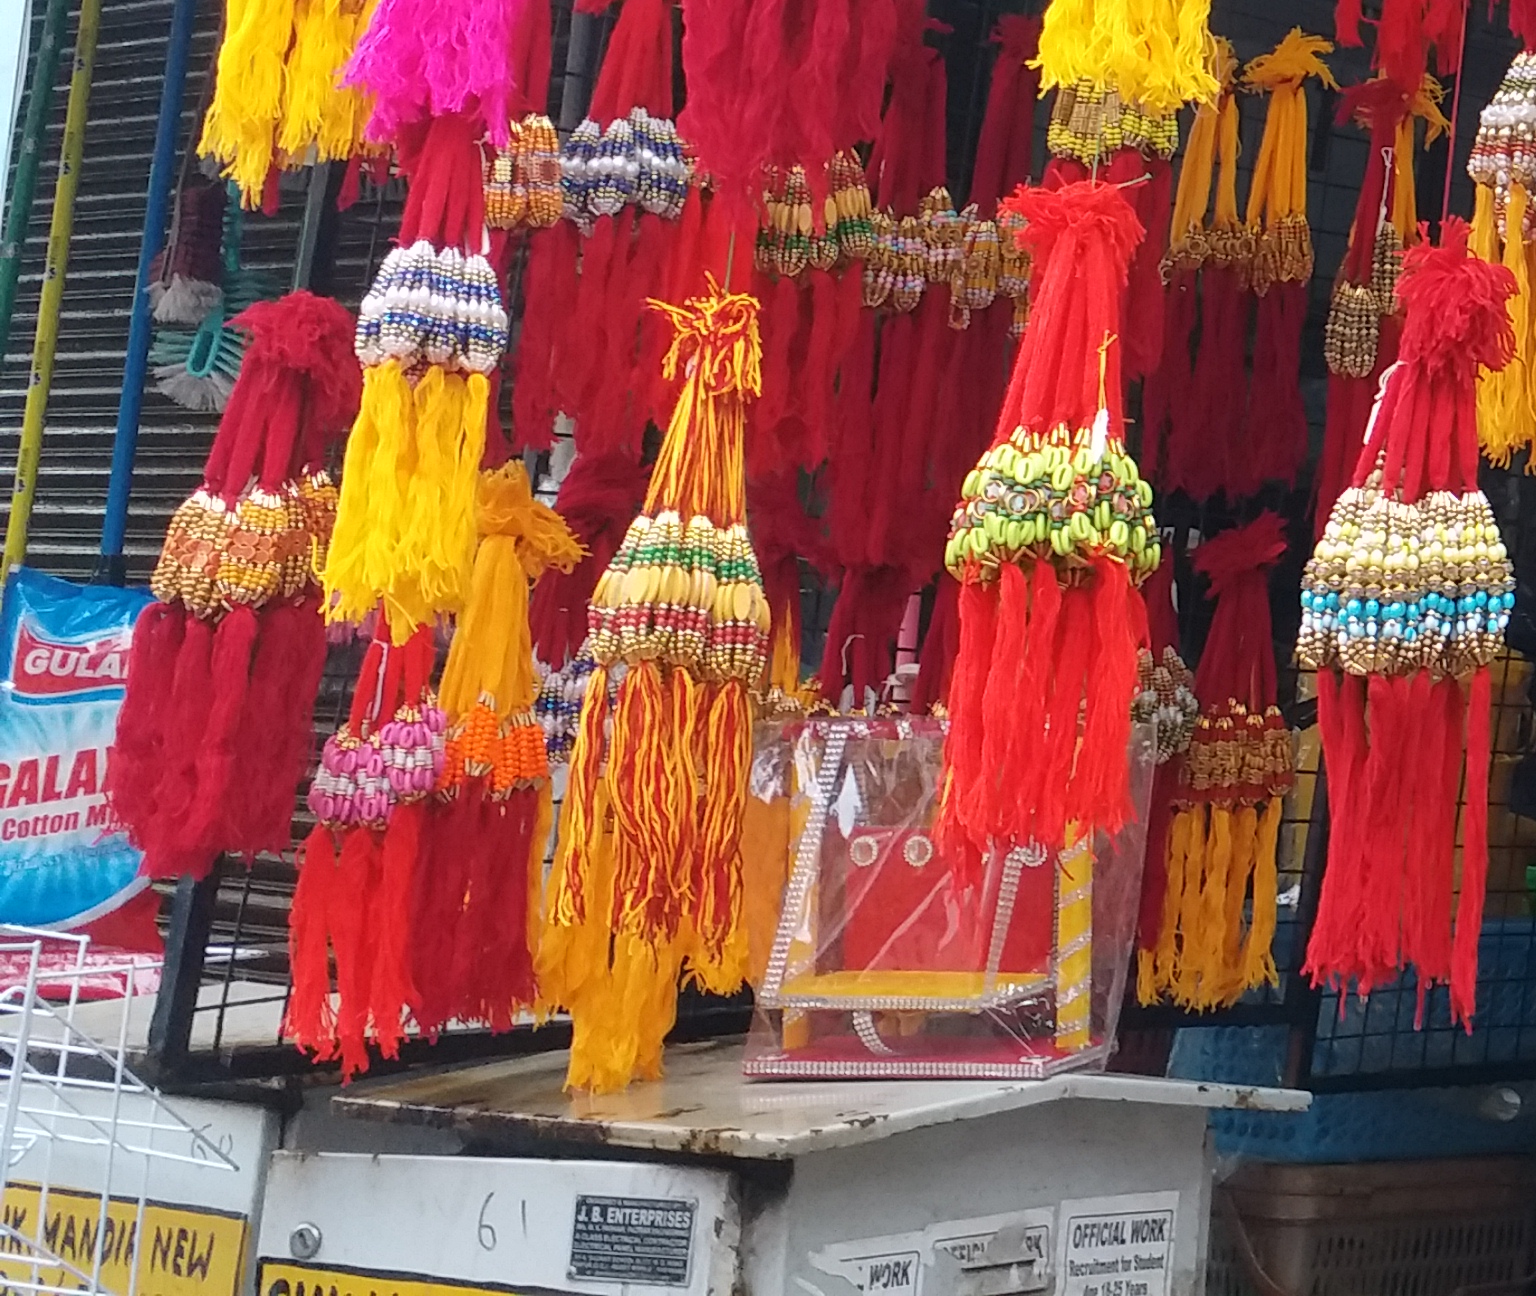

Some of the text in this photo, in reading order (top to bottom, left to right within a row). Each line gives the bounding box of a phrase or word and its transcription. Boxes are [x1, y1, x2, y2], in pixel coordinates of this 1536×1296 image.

[23, 648, 130, 680] GULA
[1, 810, 79, 841] Cotton
[576, 1205, 691, 1229] J. B. ENTERPRISES
[1073, 1217, 1168, 1249] OFFICIAL WORK
[151, 1225, 215, 1282] NEW
